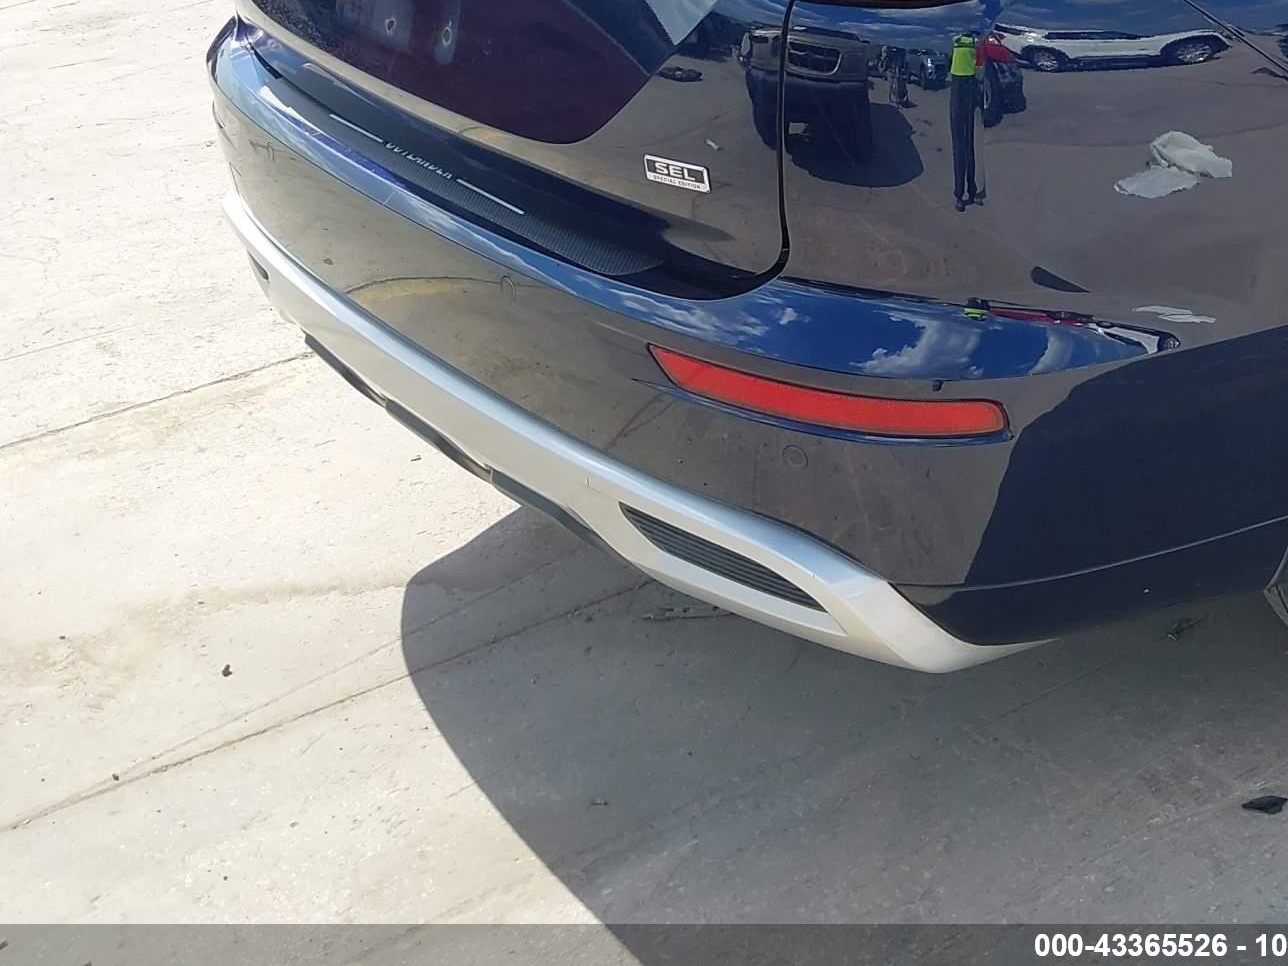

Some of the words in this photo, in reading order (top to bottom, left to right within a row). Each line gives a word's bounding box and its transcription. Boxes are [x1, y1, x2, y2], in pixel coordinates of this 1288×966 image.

[654, 161, 696, 182] SEL
[653, 174, 677, 184] SPECIAL
[677, 180, 701, 189] EDITION
